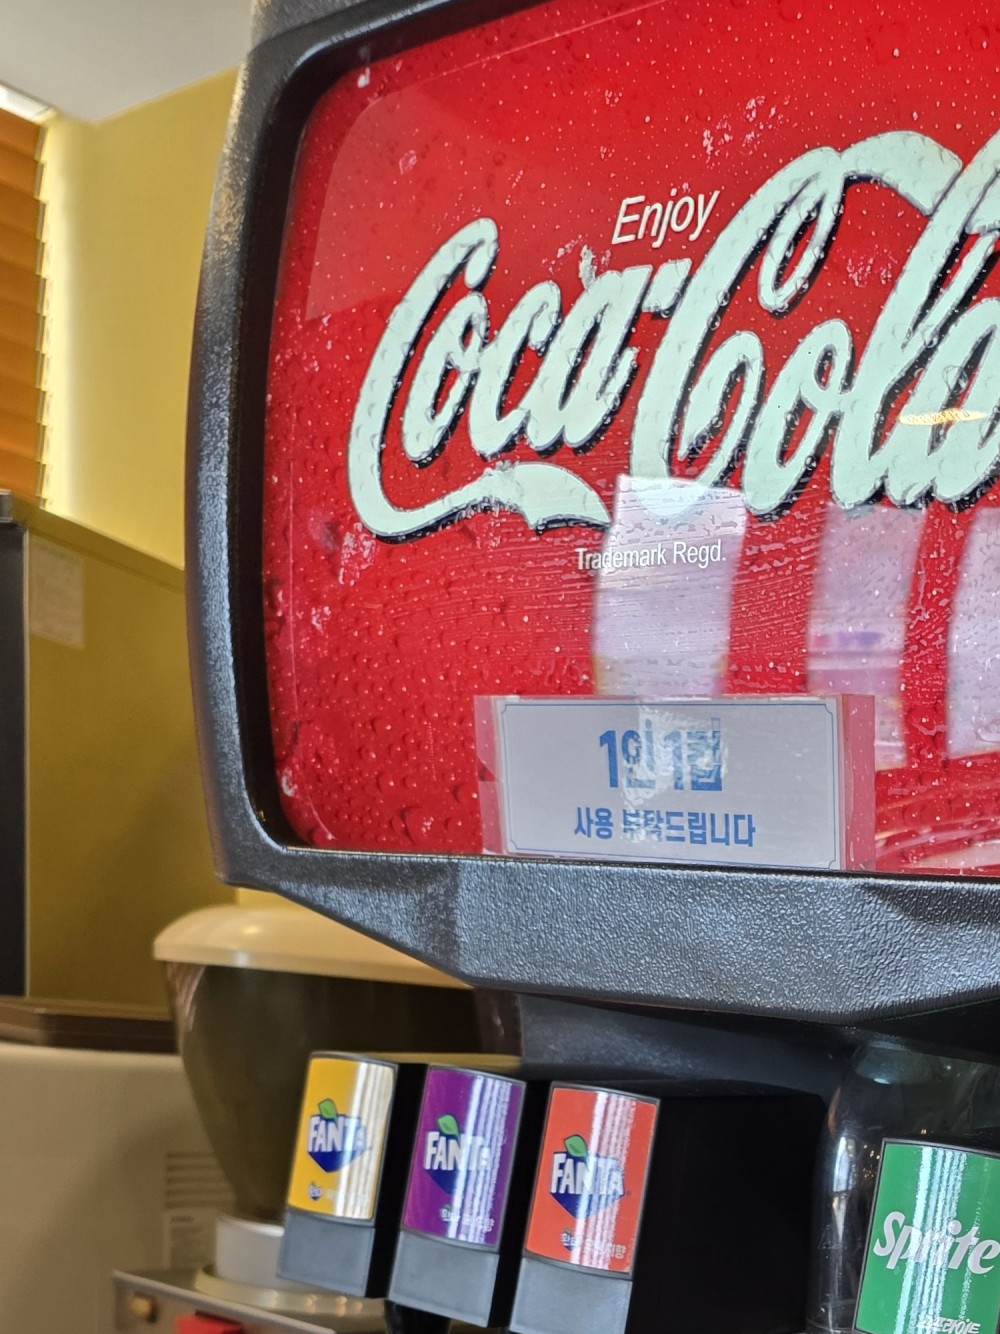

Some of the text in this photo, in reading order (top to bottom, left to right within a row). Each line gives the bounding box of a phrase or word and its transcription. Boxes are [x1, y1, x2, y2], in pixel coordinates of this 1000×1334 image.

[611, 188, 721, 249] Enjoy
[574, 538, 727, 570] Trademark Regd.
[574, 806, 756, 848] 사용 부탁드립니다
[307, 1115, 367, 1153] FANTA
[423, 1131, 493, 1171] FANTA
[550, 1152, 625, 1195] FANTA
